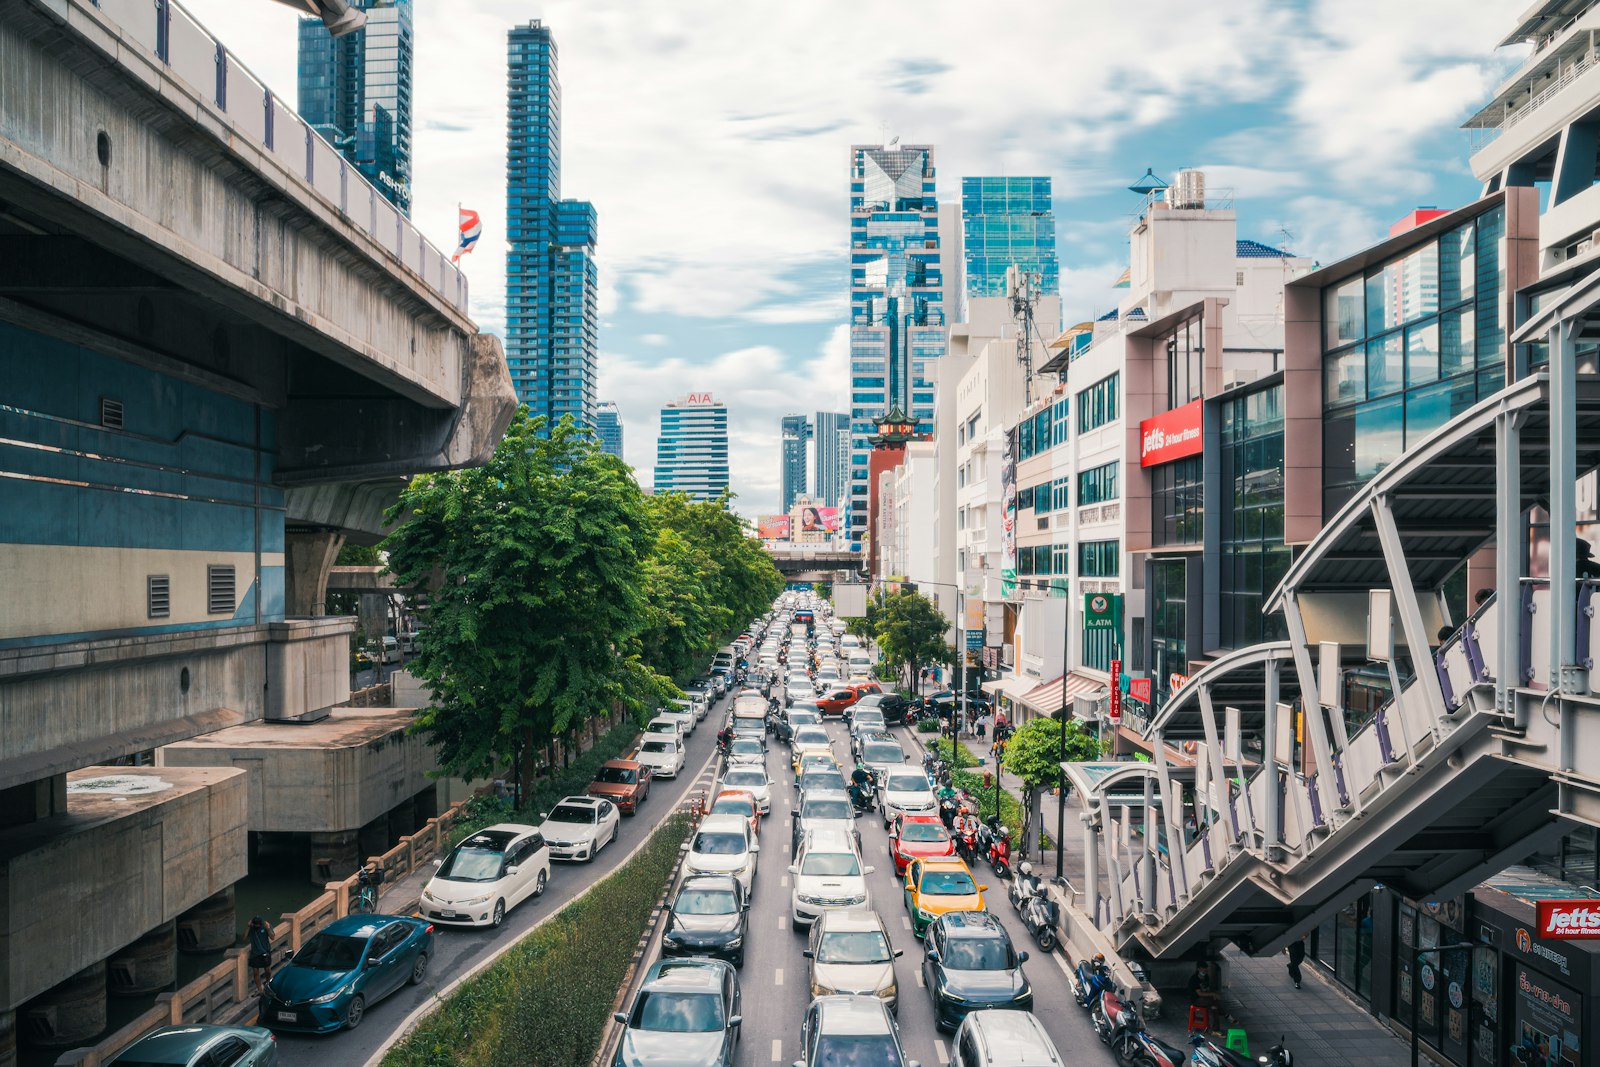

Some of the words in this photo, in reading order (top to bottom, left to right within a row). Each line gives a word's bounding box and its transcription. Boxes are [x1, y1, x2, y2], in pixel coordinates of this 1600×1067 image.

[530, 20, 539, 29] M
[688, 393, 712, 404] AIA
[1142, 427, 1165, 458] jetts
[1165, 434, 1172, 447] 24
[1171, 432, 1184, 444] hour
[1183, 427, 1200, 441] fitness
[1546, 907, 1600, 932] jetts
